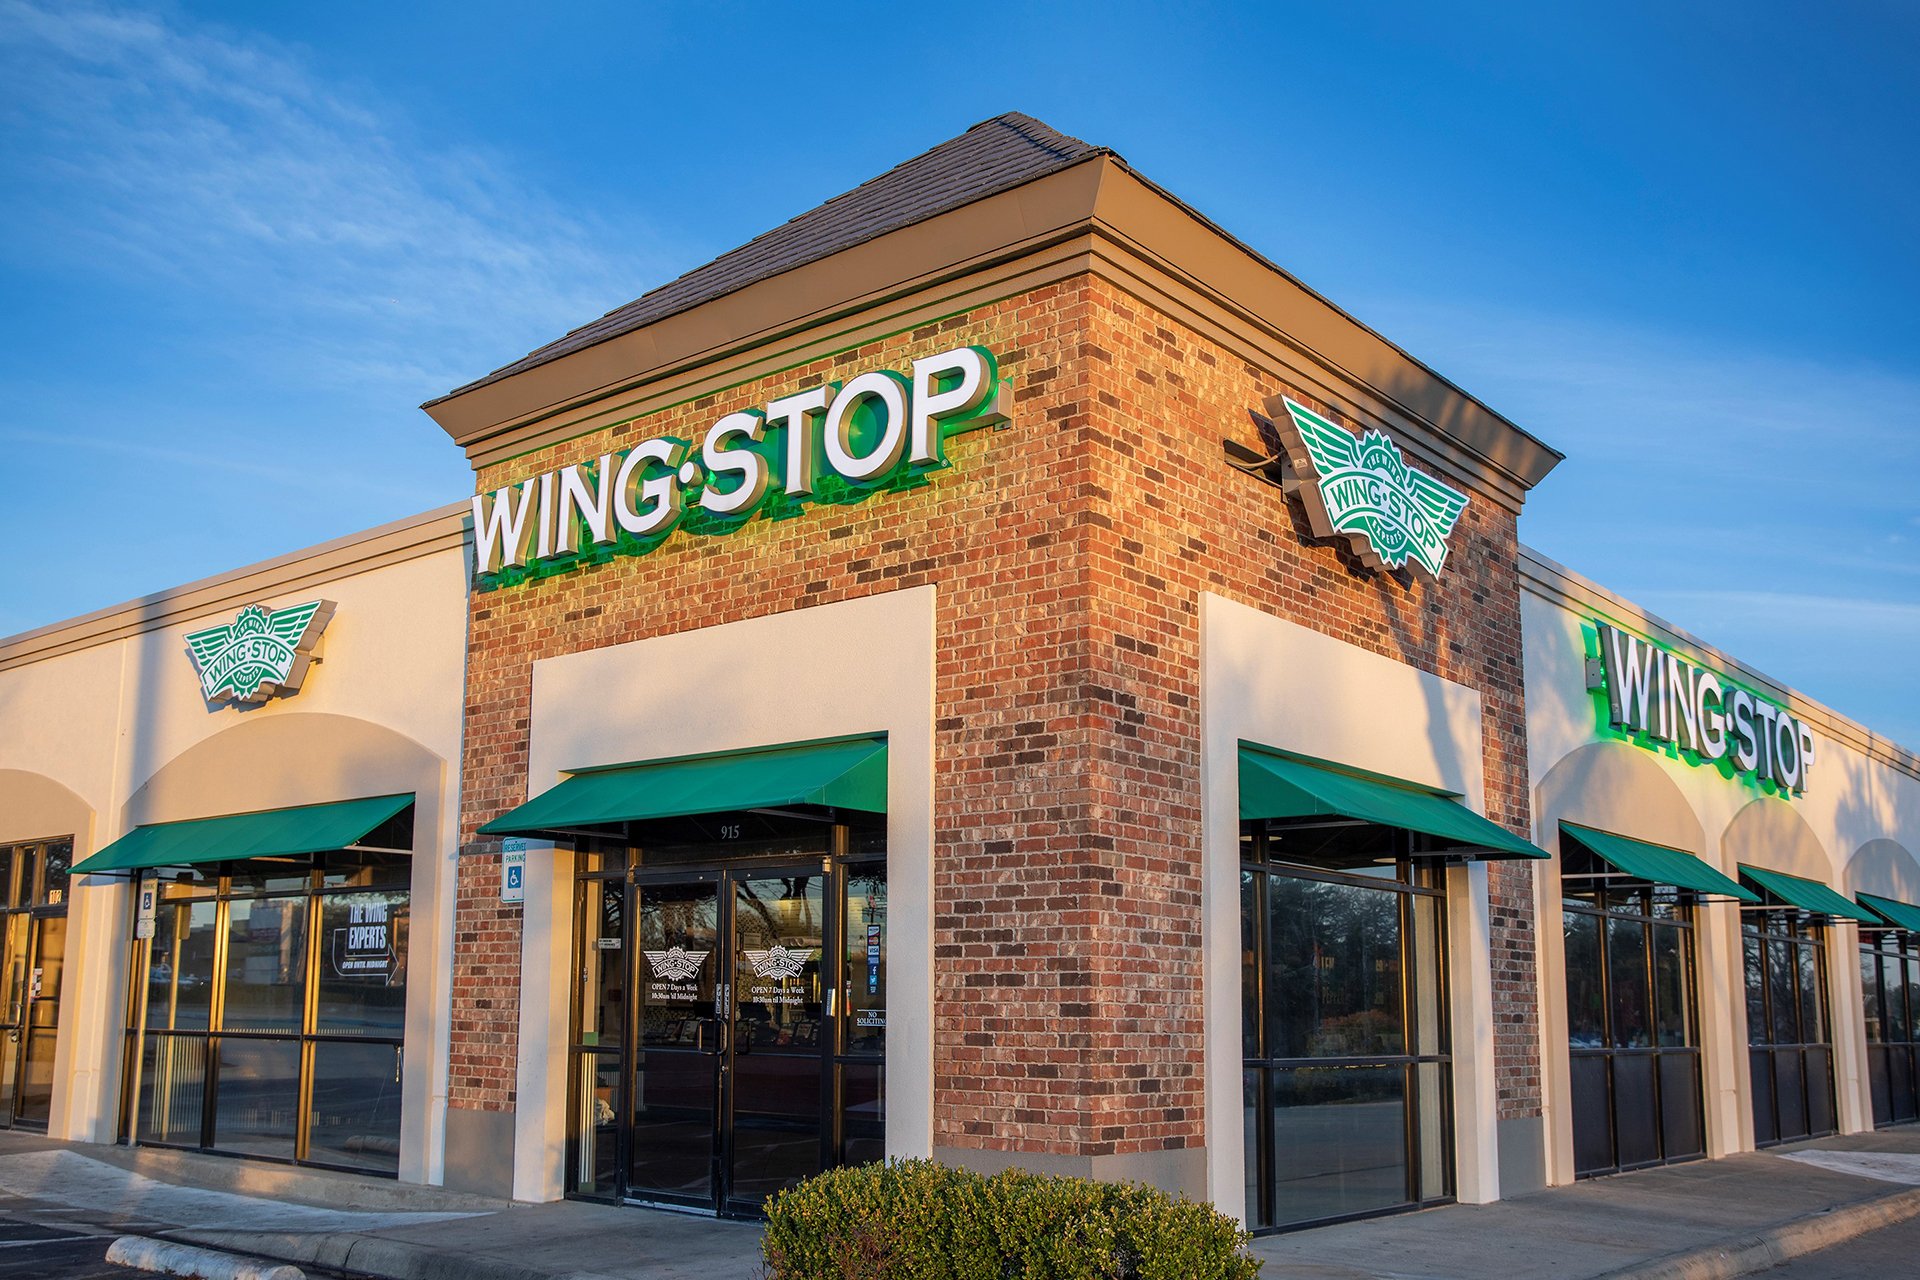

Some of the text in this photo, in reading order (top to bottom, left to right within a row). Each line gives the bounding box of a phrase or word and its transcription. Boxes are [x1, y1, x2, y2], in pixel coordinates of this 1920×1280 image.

[1367, 453, 1401, 484] THE WING
[1371, 520, 1402, 546] EXPERTS
[237, 619, 263, 638] THE WING
[236, 667, 259, 683] EXPERTS
[721, 825, 740, 839] 915
[350, 902, 388, 923] THE WING
[348, 925, 387, 949] EXPERTS
[671, 983, 682, 992] Days
[773, 986, 785, 995] Days
[790, 986, 805, 994] Week
